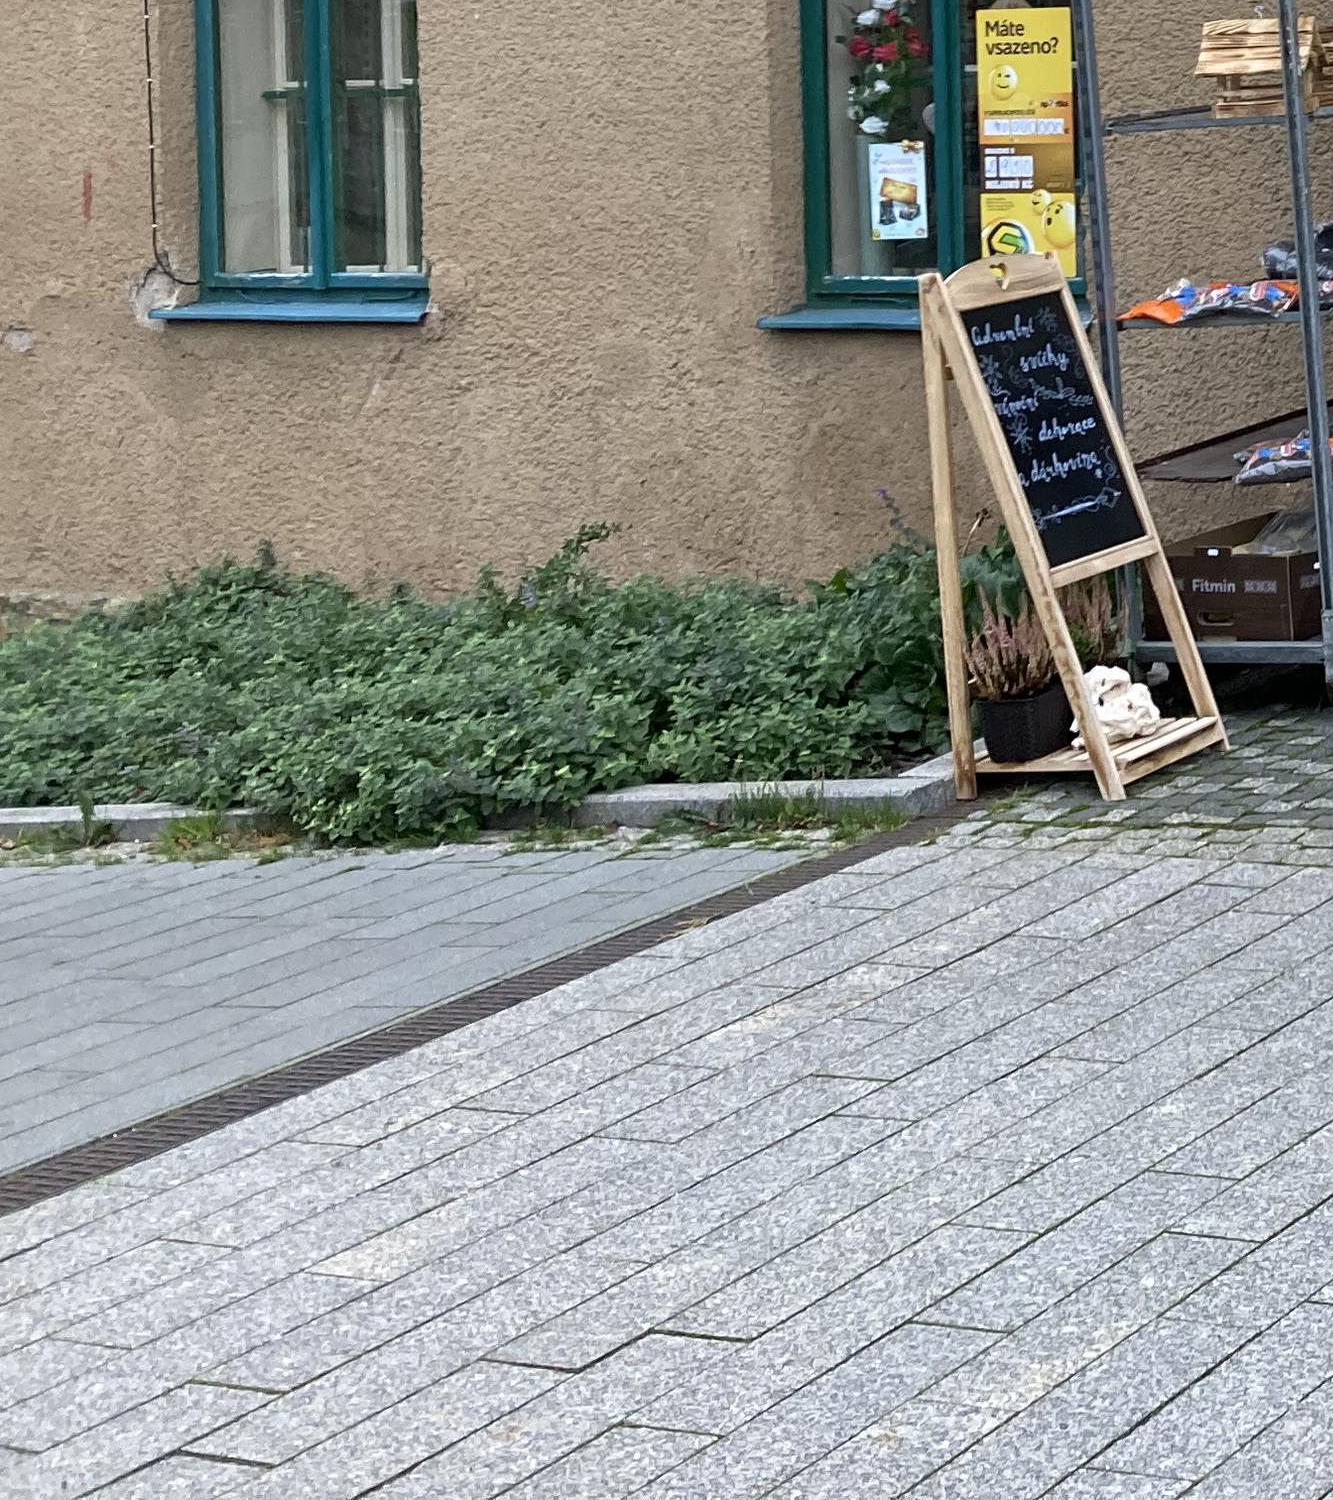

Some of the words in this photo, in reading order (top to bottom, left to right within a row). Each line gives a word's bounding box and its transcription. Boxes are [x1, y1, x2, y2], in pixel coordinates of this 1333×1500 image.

[985, 20, 1024, 38] Máte
[986, 37, 1058, 55] vsazeno?
[1038, 417, 1097, 441] dekorace
[1192, 579, 1236, 593] Fitmin
